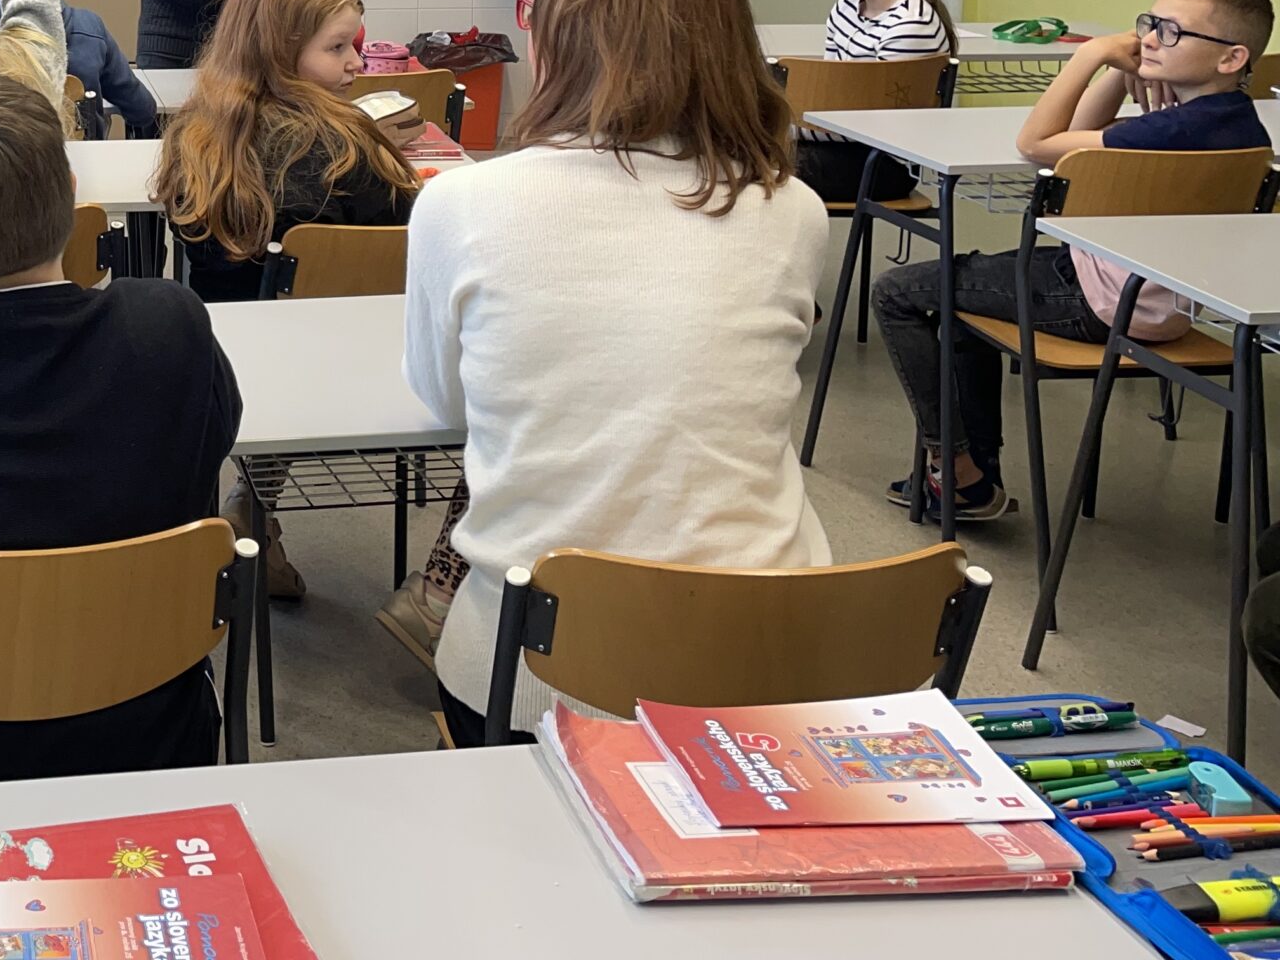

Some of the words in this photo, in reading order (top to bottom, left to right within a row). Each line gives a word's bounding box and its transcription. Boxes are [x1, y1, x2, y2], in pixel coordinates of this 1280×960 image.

[705, 719, 772, 794] slovenského
[736, 732, 781, 752] 5
[750, 752, 798, 792] jazyka
[764, 794, 789, 810] zo
[161, 888, 179, 908] zo
[195, 912, 220, 960] Pomo
